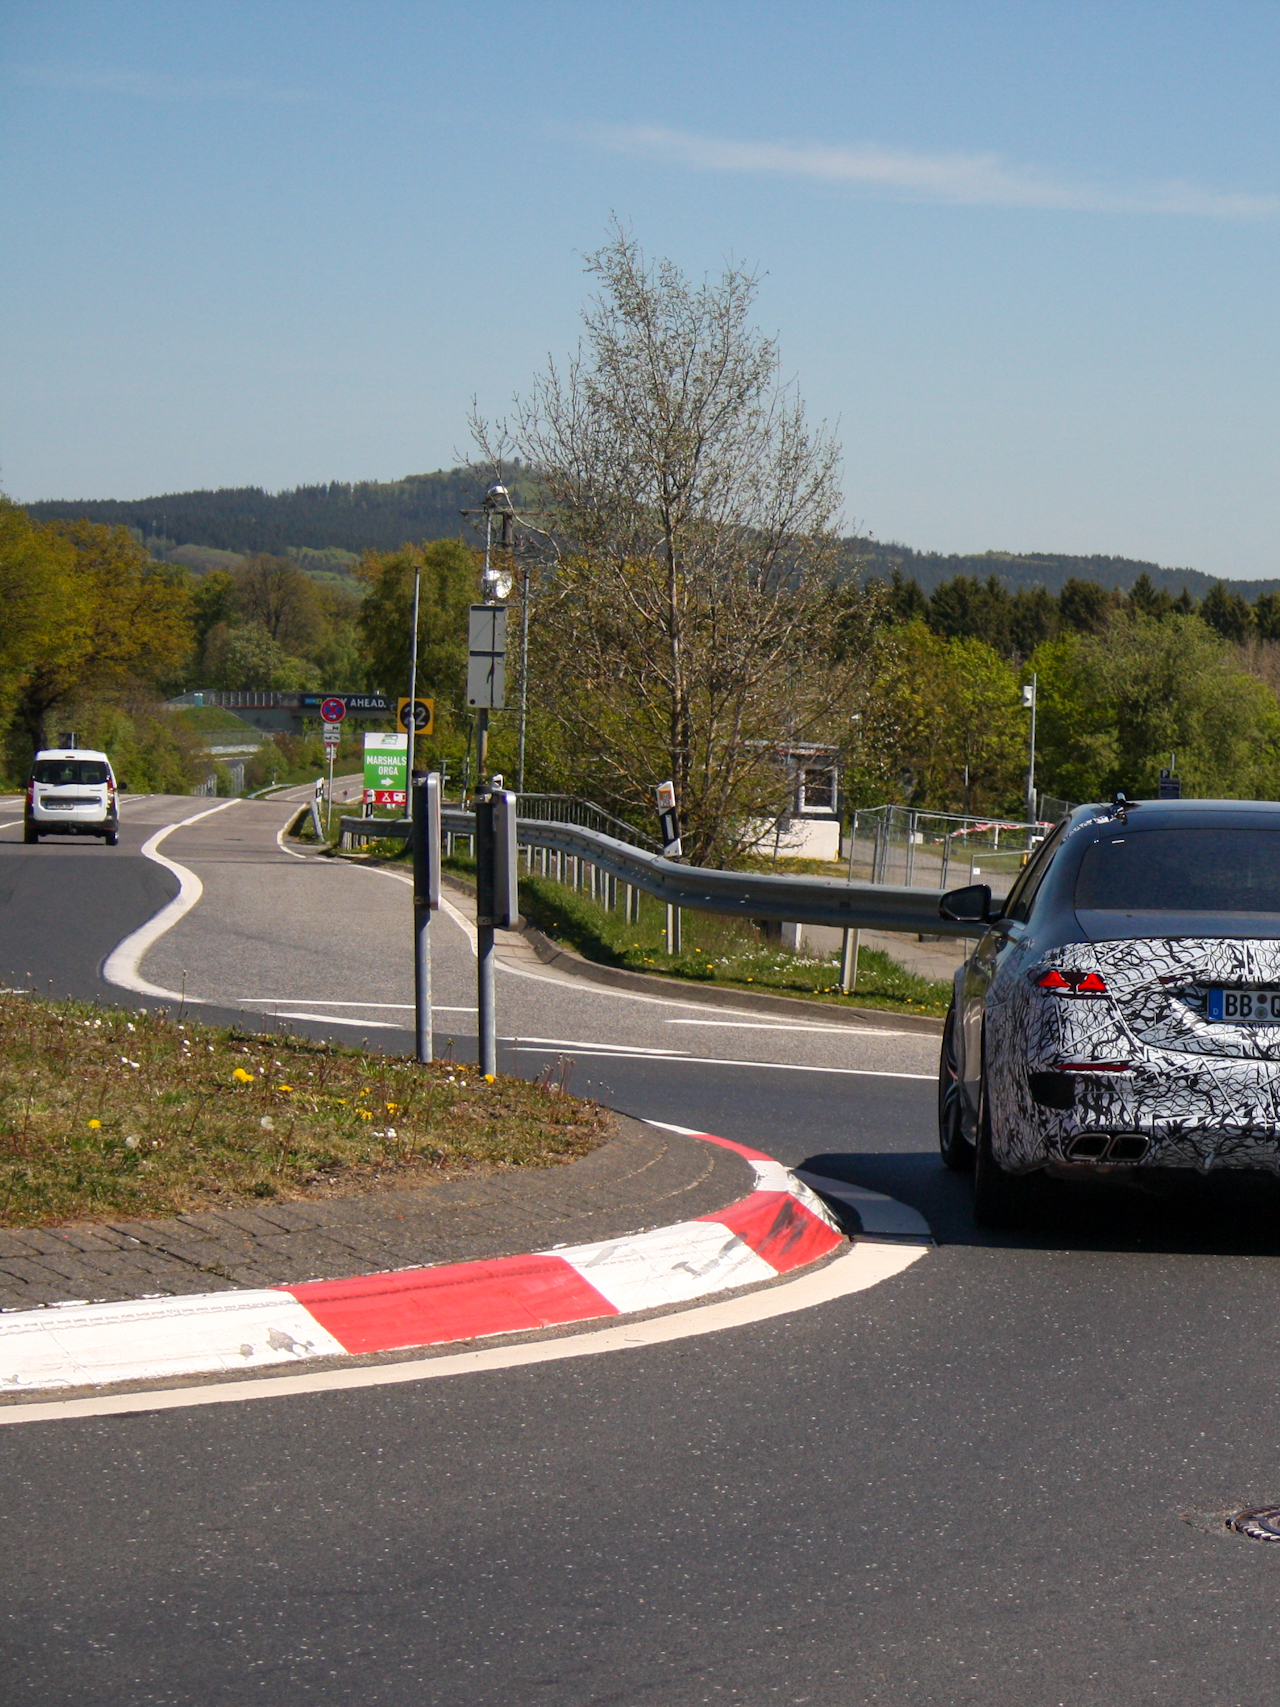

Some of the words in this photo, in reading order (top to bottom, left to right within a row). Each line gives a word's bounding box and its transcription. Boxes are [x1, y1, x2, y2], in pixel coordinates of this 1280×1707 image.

[350, 698, 387, 708] AHEAD.
[366, 755, 407, 766] MARSHALS
[378, 766, 399, 776] ORGA
[1225, 993, 1252, 1018] BB
[1212, 1007, 1219, 1016] D
